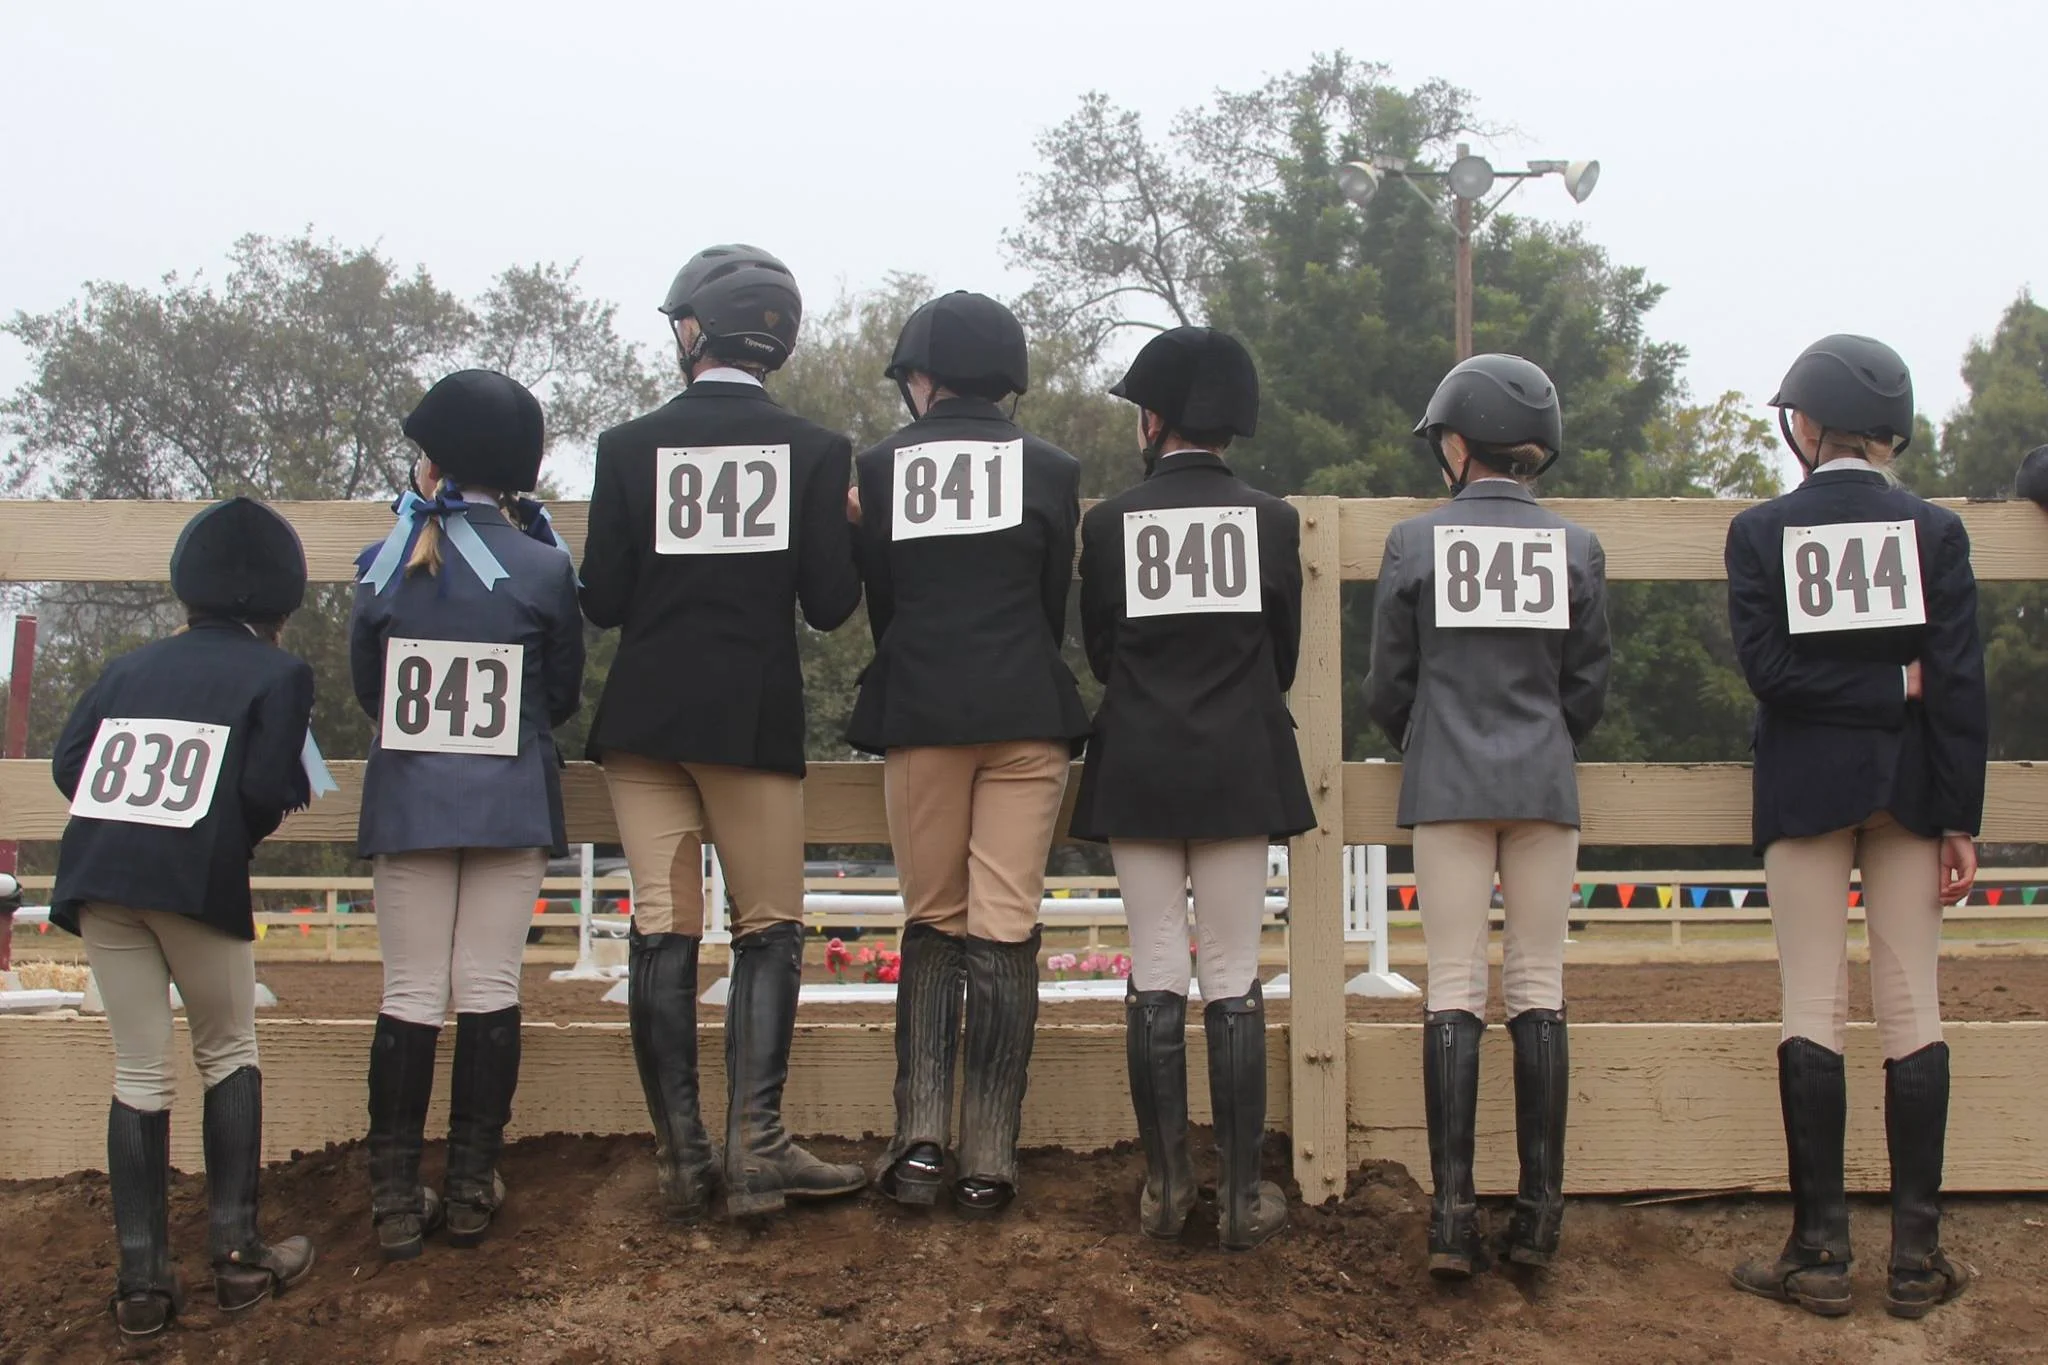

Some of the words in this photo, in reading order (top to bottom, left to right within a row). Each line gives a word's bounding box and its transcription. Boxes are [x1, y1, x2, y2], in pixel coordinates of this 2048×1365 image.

[668, 460, 777, 540] 842
[904, 453, 1002, 524] 841
[1136, 522, 1247, 600] 840
[1446, 540, 1554, 613] 845
[1795, 536, 1907, 617] 844
[395, 655, 508, 739] 843
[90, 731, 211, 812] 839
